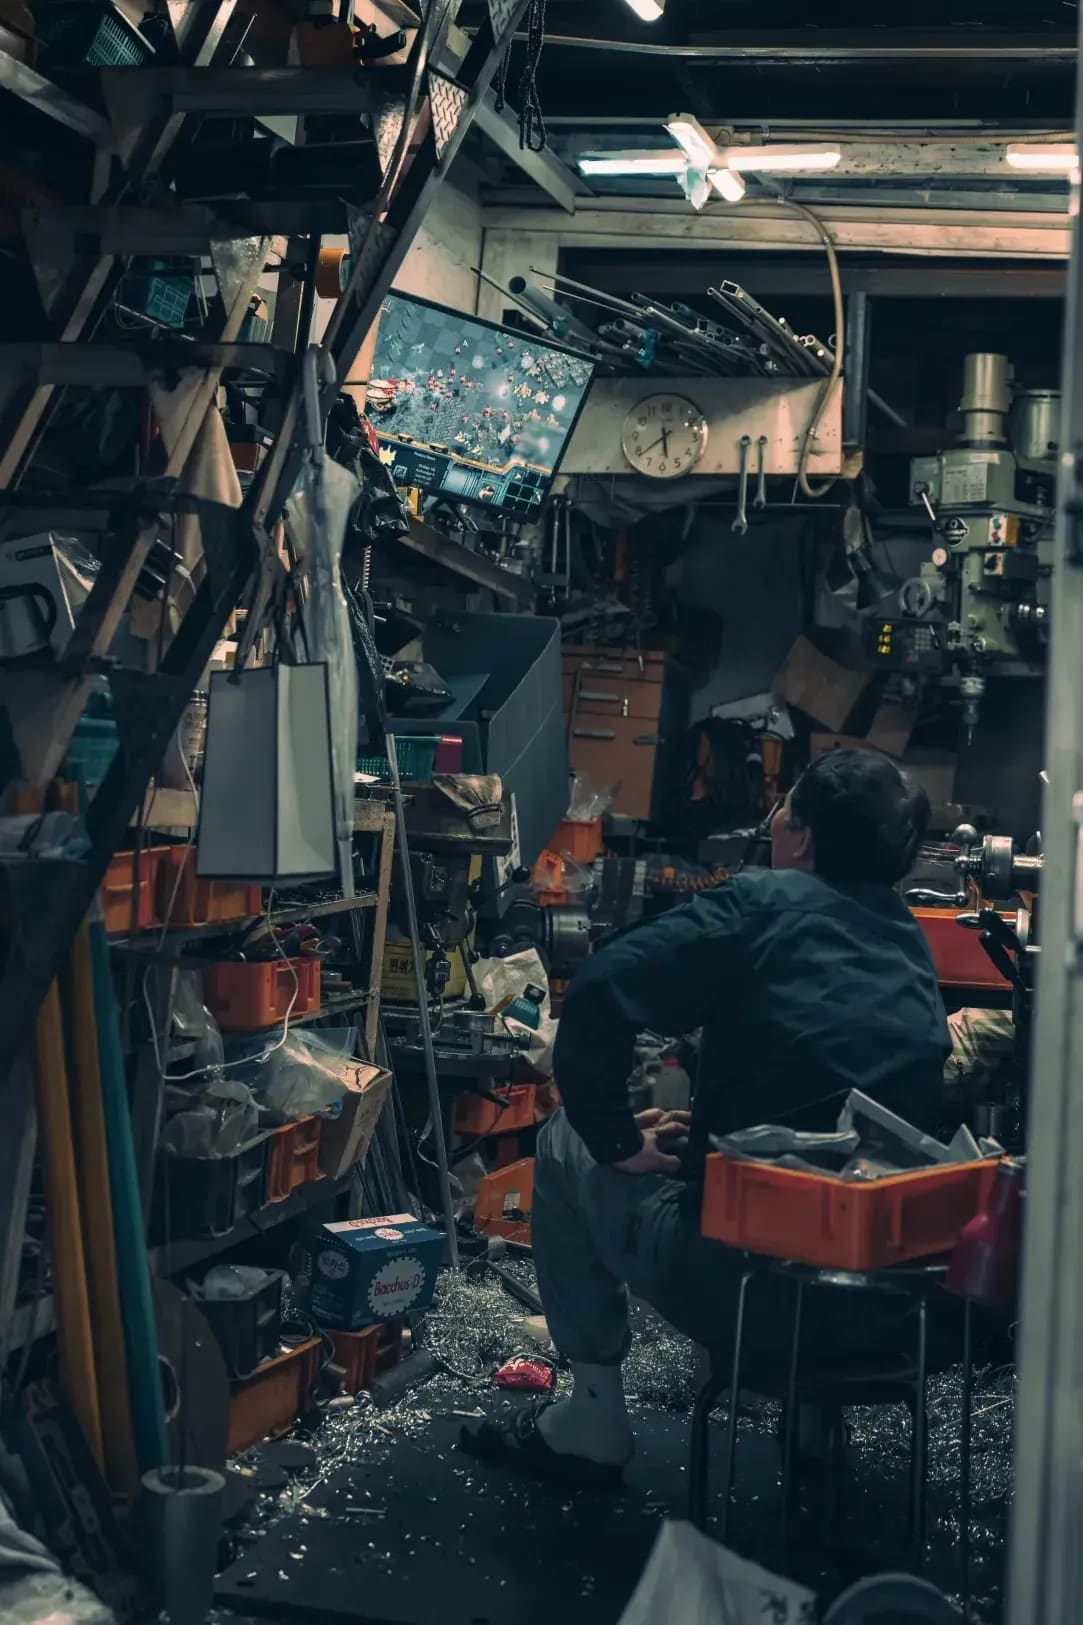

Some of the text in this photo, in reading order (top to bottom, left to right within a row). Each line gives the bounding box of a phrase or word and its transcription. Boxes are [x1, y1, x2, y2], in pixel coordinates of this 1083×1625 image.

[648, 405, 656, 416] 11
[662, 402, 672, 414] 12
[638, 416, 647, 426] 10
[688, 418, 695, 427] 2
[632, 431, 639, 441] 9
[692, 433, 698, 442] 3
[635, 446, 642, 456] 8
[685, 448, 692, 457] 4
[646, 457, 653, 467] 7
[659, 461, 666, 472] 6
[674, 458, 681, 468] 5
[374, 1274, 420, 1296] Bacchus-D
